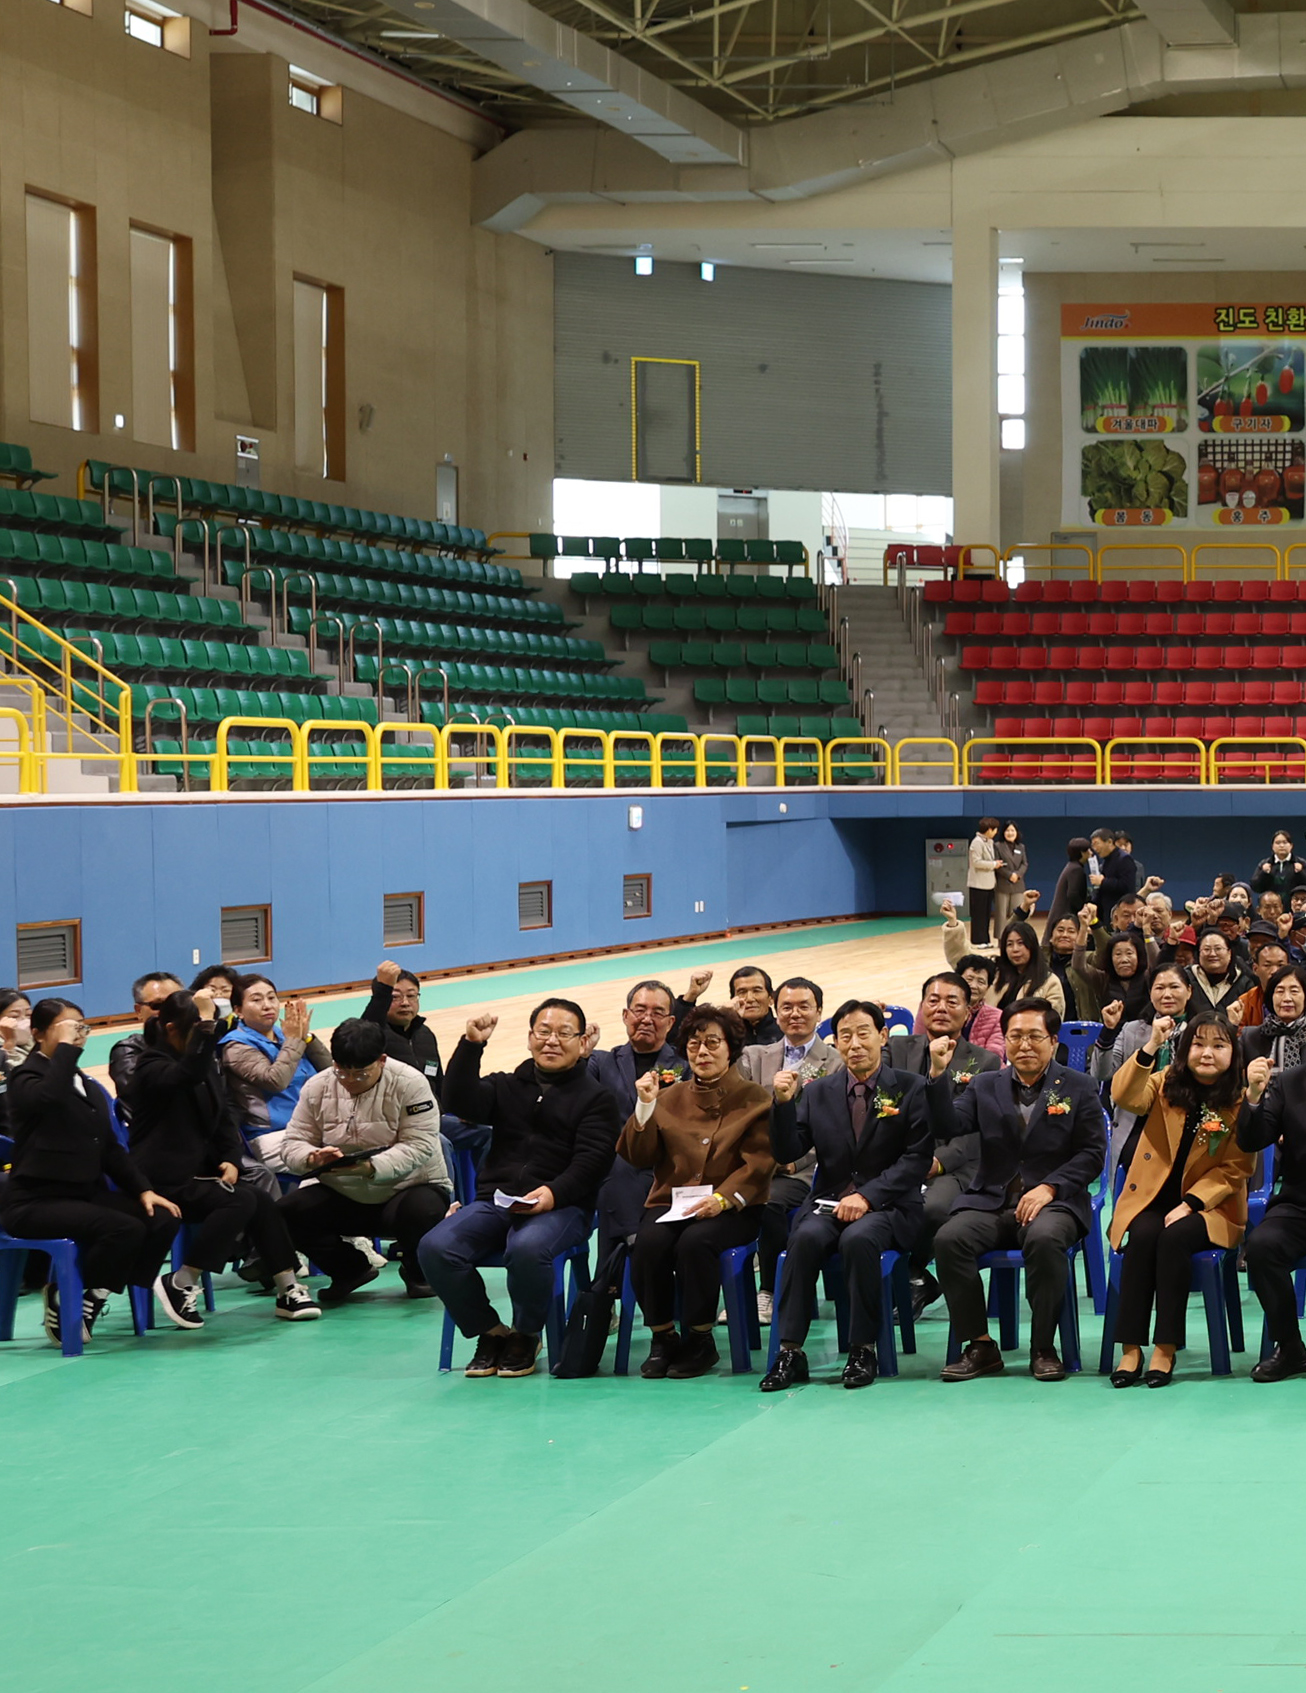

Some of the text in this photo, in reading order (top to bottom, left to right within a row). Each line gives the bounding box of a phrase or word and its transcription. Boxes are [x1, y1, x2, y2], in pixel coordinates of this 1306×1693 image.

[1080, 315, 1124, 330] Jindo
[1214, 306, 1259, 331] 진도
[1111, 417, 1159, 430] 겨울대파
[1231, 418, 1272, 430] 구기자
